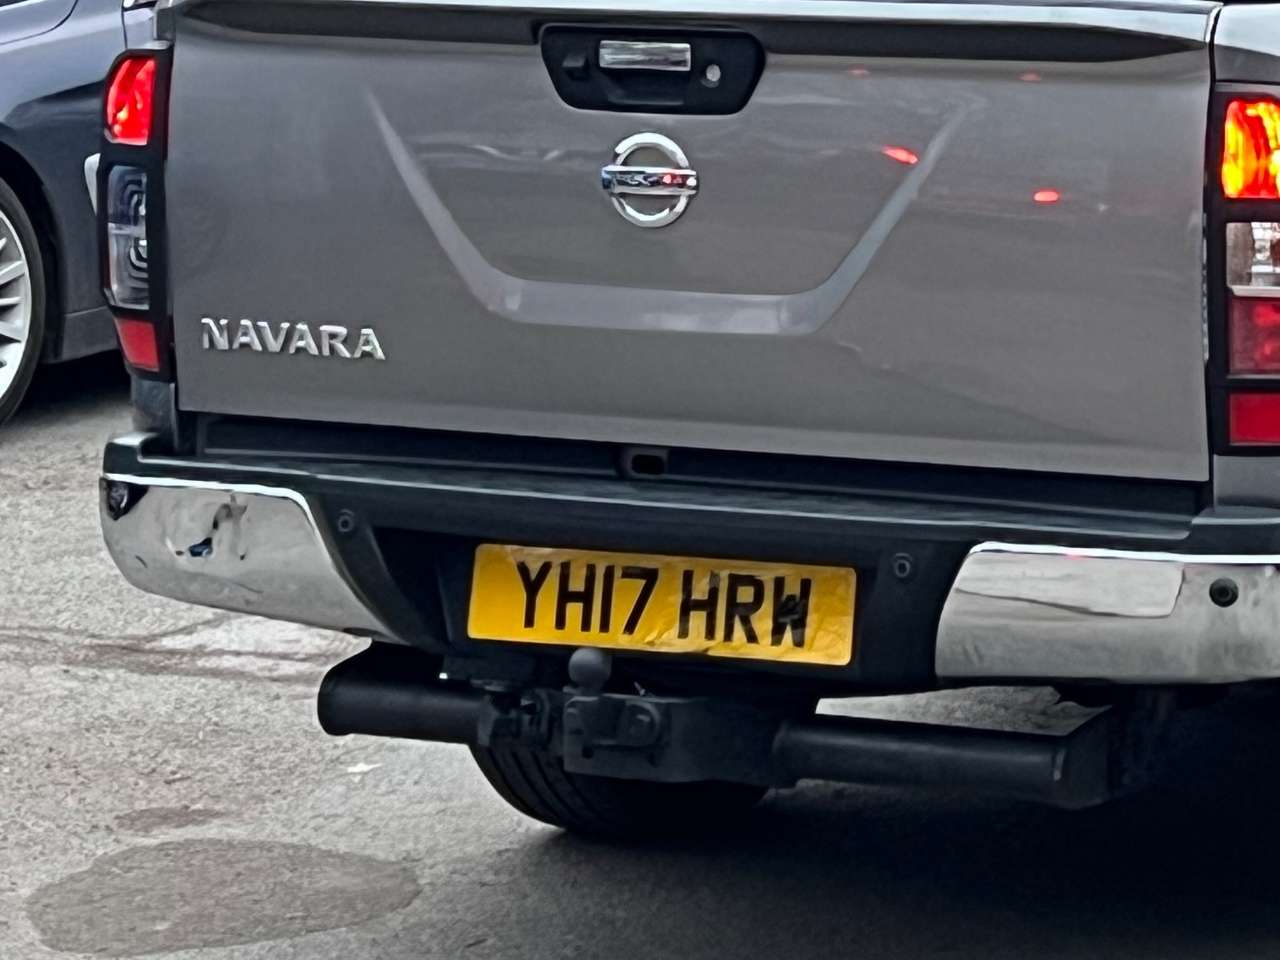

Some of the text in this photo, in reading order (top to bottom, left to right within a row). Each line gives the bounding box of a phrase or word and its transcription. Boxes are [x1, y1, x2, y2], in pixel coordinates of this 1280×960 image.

[200, 317, 386, 360] NAVARA
[516, 560, 812, 647] YH17 HRW
